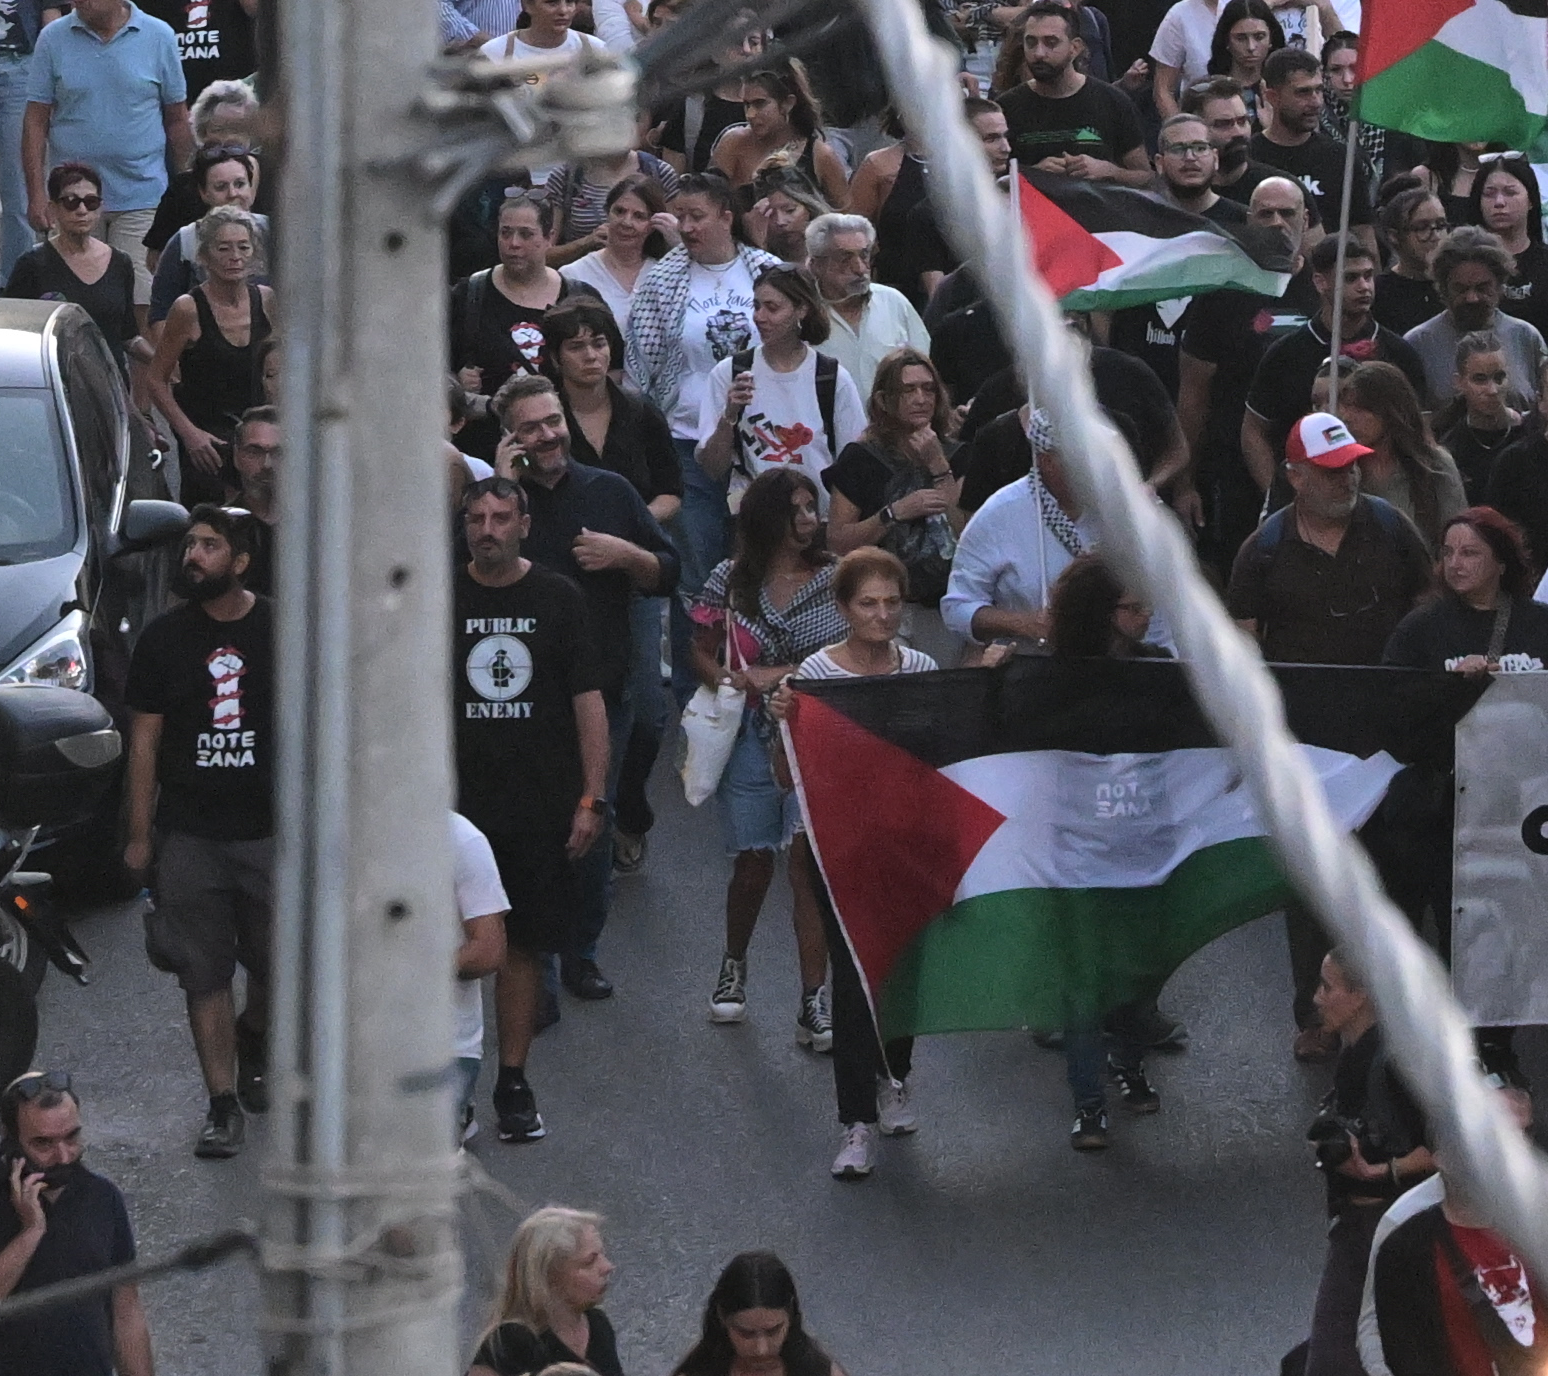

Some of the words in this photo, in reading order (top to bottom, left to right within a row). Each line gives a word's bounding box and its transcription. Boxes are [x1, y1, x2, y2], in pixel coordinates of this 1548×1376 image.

[466, 617, 536, 635] PUBLIC
[466, 701, 534, 719] ENEMY
[197, 731, 254, 749] ΠΟΤΕ
[196, 749, 255, 768] ΞΑΝΑ
